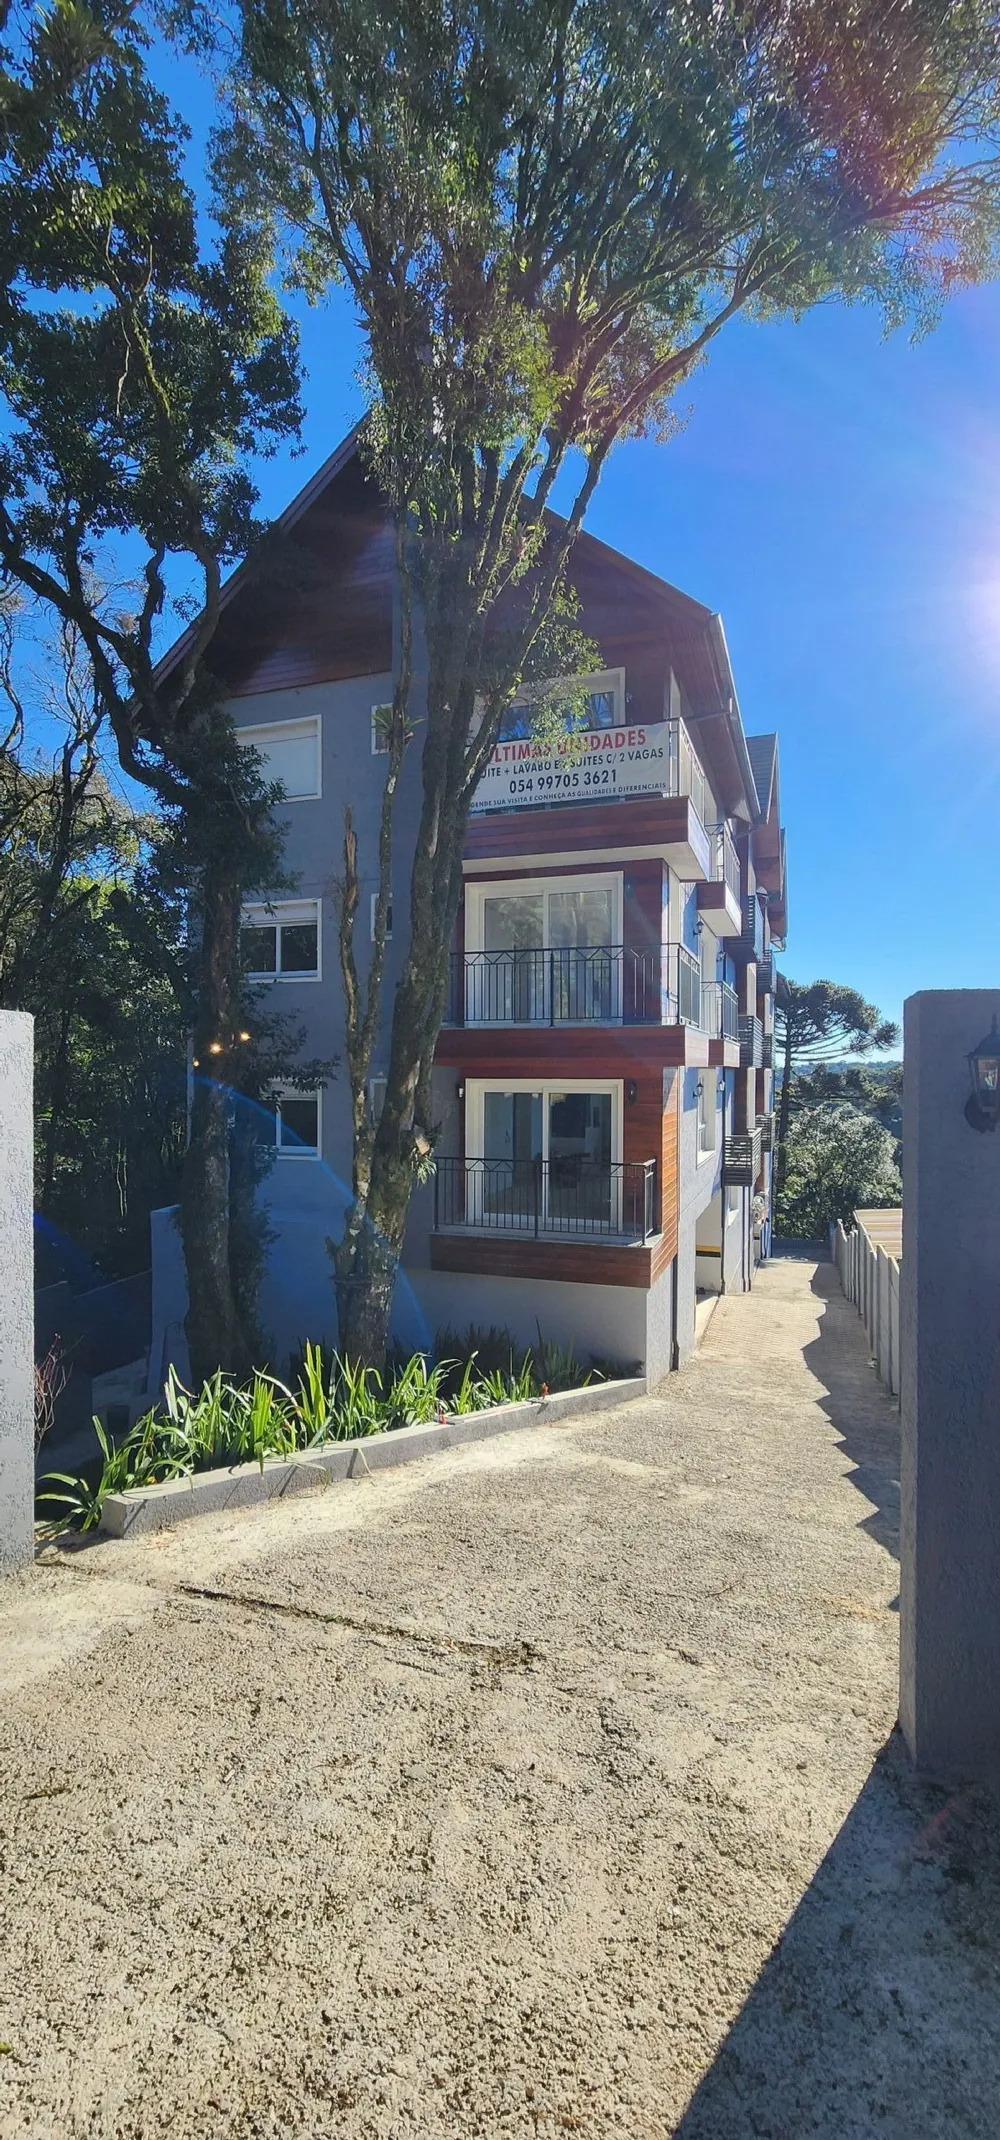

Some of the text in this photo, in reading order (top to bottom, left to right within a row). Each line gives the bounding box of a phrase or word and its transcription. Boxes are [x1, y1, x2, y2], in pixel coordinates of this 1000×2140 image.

[480, 767, 501, 778] UITE
[513, 761, 551, 775] LAVABO
[570, 755, 603, 768] SUITES
[606, 753, 617, 764] C/
[619, 752, 625, 762] 2
[627, 747, 664, 761] VAGAS
[509, 769, 616, 794] 054 99705 3621
[534, 792, 566, 801] CONHEÇA
[577, 788, 612, 797] QUALIDADES
[618, 782, 666, 793] DIFERENCIAIS
